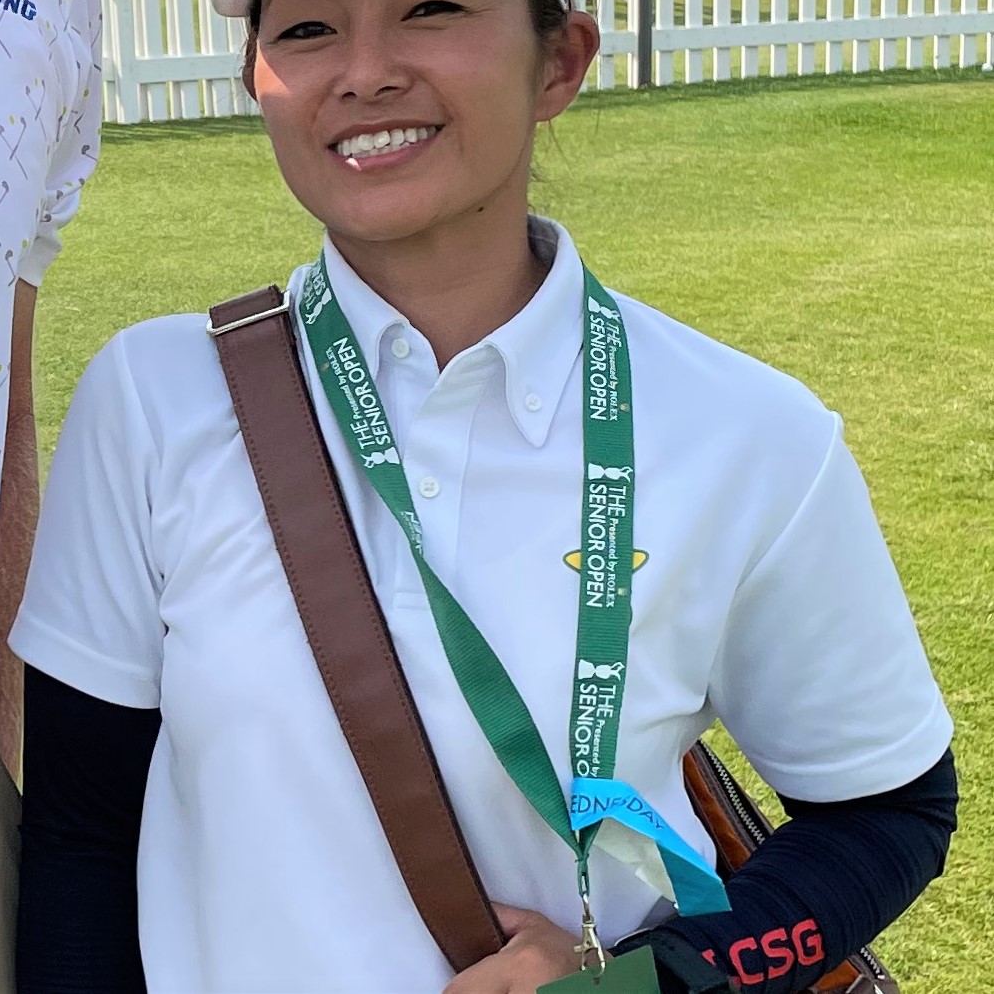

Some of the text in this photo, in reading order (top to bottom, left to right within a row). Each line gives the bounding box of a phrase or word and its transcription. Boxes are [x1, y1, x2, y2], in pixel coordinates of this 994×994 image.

[589, 314, 608, 421] SENIOR OPEN
[606, 321, 622, 348] THE
[333, 337, 391, 446] SENIOR OPEN
[350, 419, 376, 449] THE
[586, 483, 608, 608] SENIOR OPEN
[606, 485, 627, 608] THE Presented by ROLEX
[575, 683, 598, 757] SENIOR
[590, 685, 617, 778] THE Presented by
[704, 918, 825, 988] CSG
